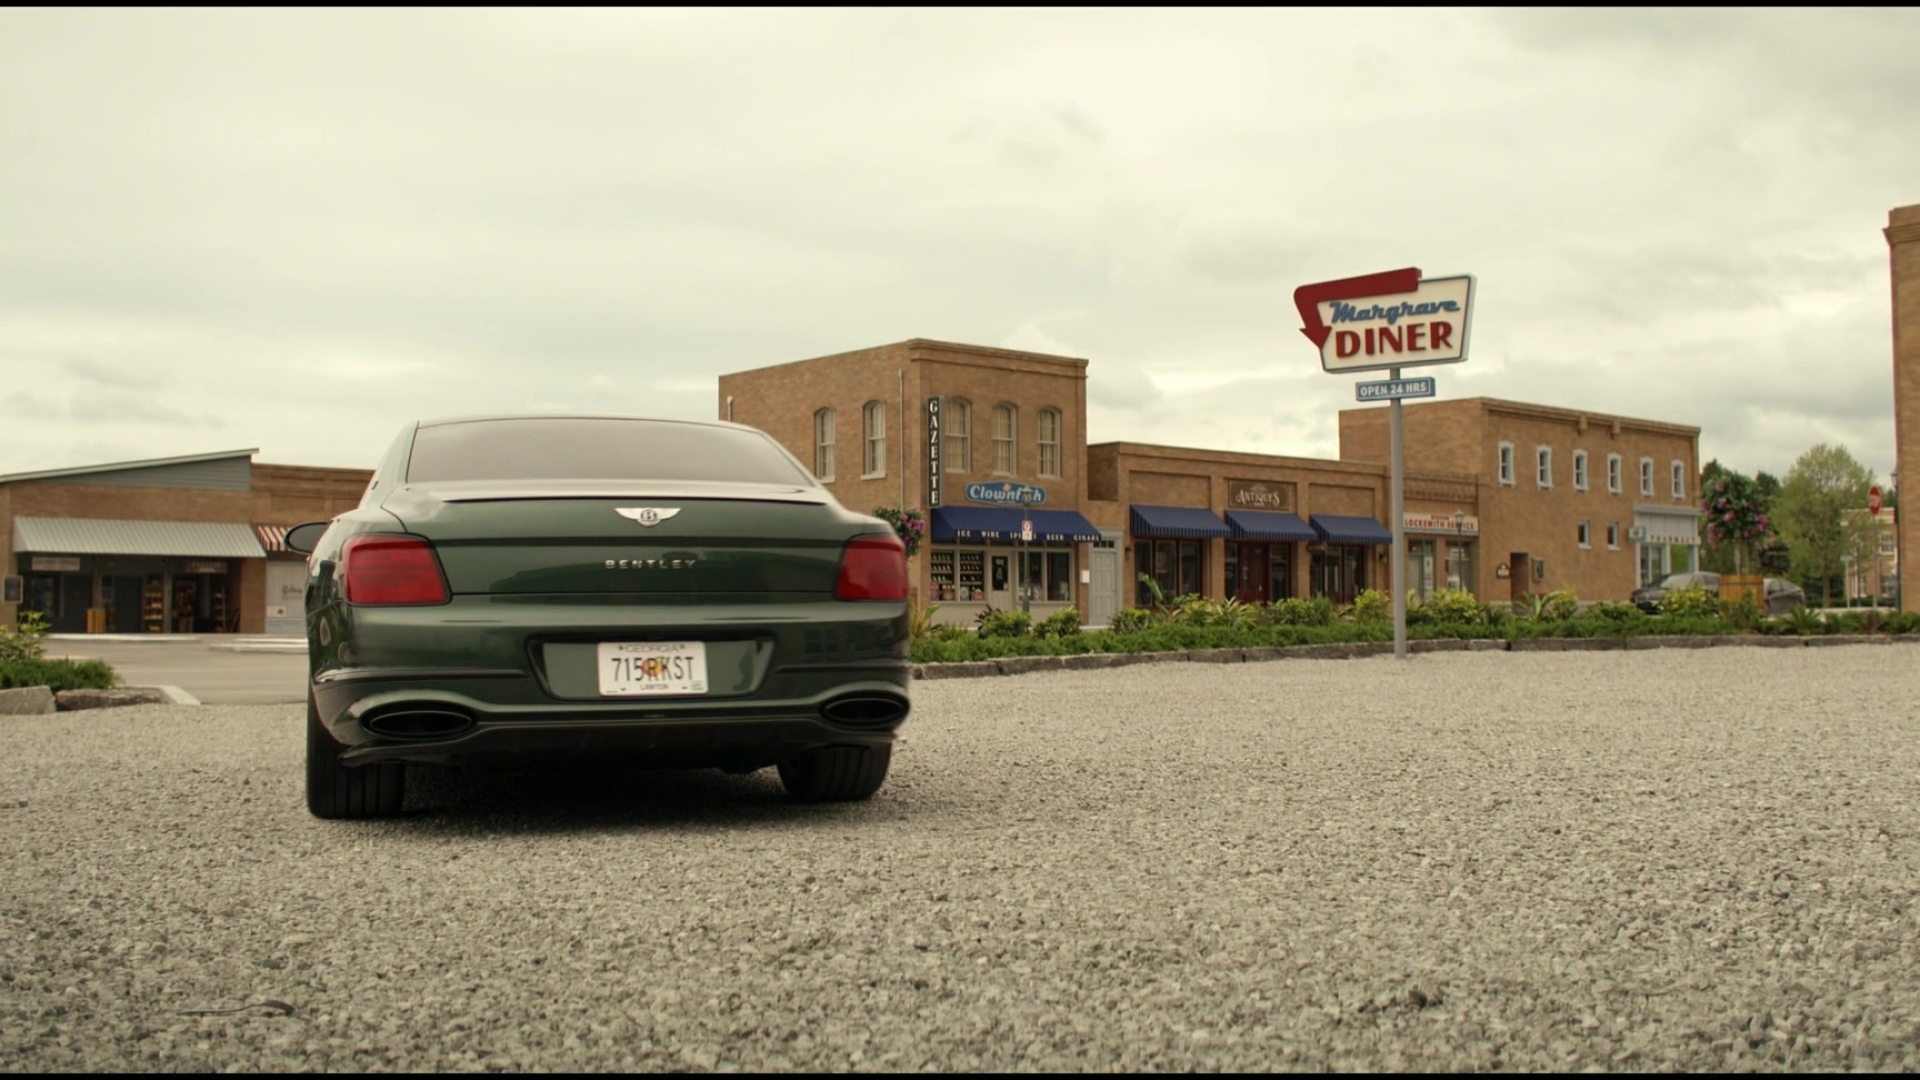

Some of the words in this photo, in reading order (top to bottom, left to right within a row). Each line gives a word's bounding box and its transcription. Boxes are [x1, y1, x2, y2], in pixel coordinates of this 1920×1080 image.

[1329, 299, 1461, 325] Margrave
[1335, 320, 1454, 358] DINER
[1360, 385, 1388, 396] OPEN
[1390, 383, 1404, 394] 24
[1405, 381, 1427, 393] HRS
[929, 399, 939, 505] GAZETTE
[969, 484, 1042, 502] Clownfh
[1235, 489, 1281, 508] ANTIQUES
[1404, 518, 1446, 528] LOCKSMITH
[1447, 520, 1474, 530] SERICE
[604, 559, 697, 569] BENTLEY
[625, 643, 680, 653] GEORGIA
[611, 656, 694, 682] 715RKST
